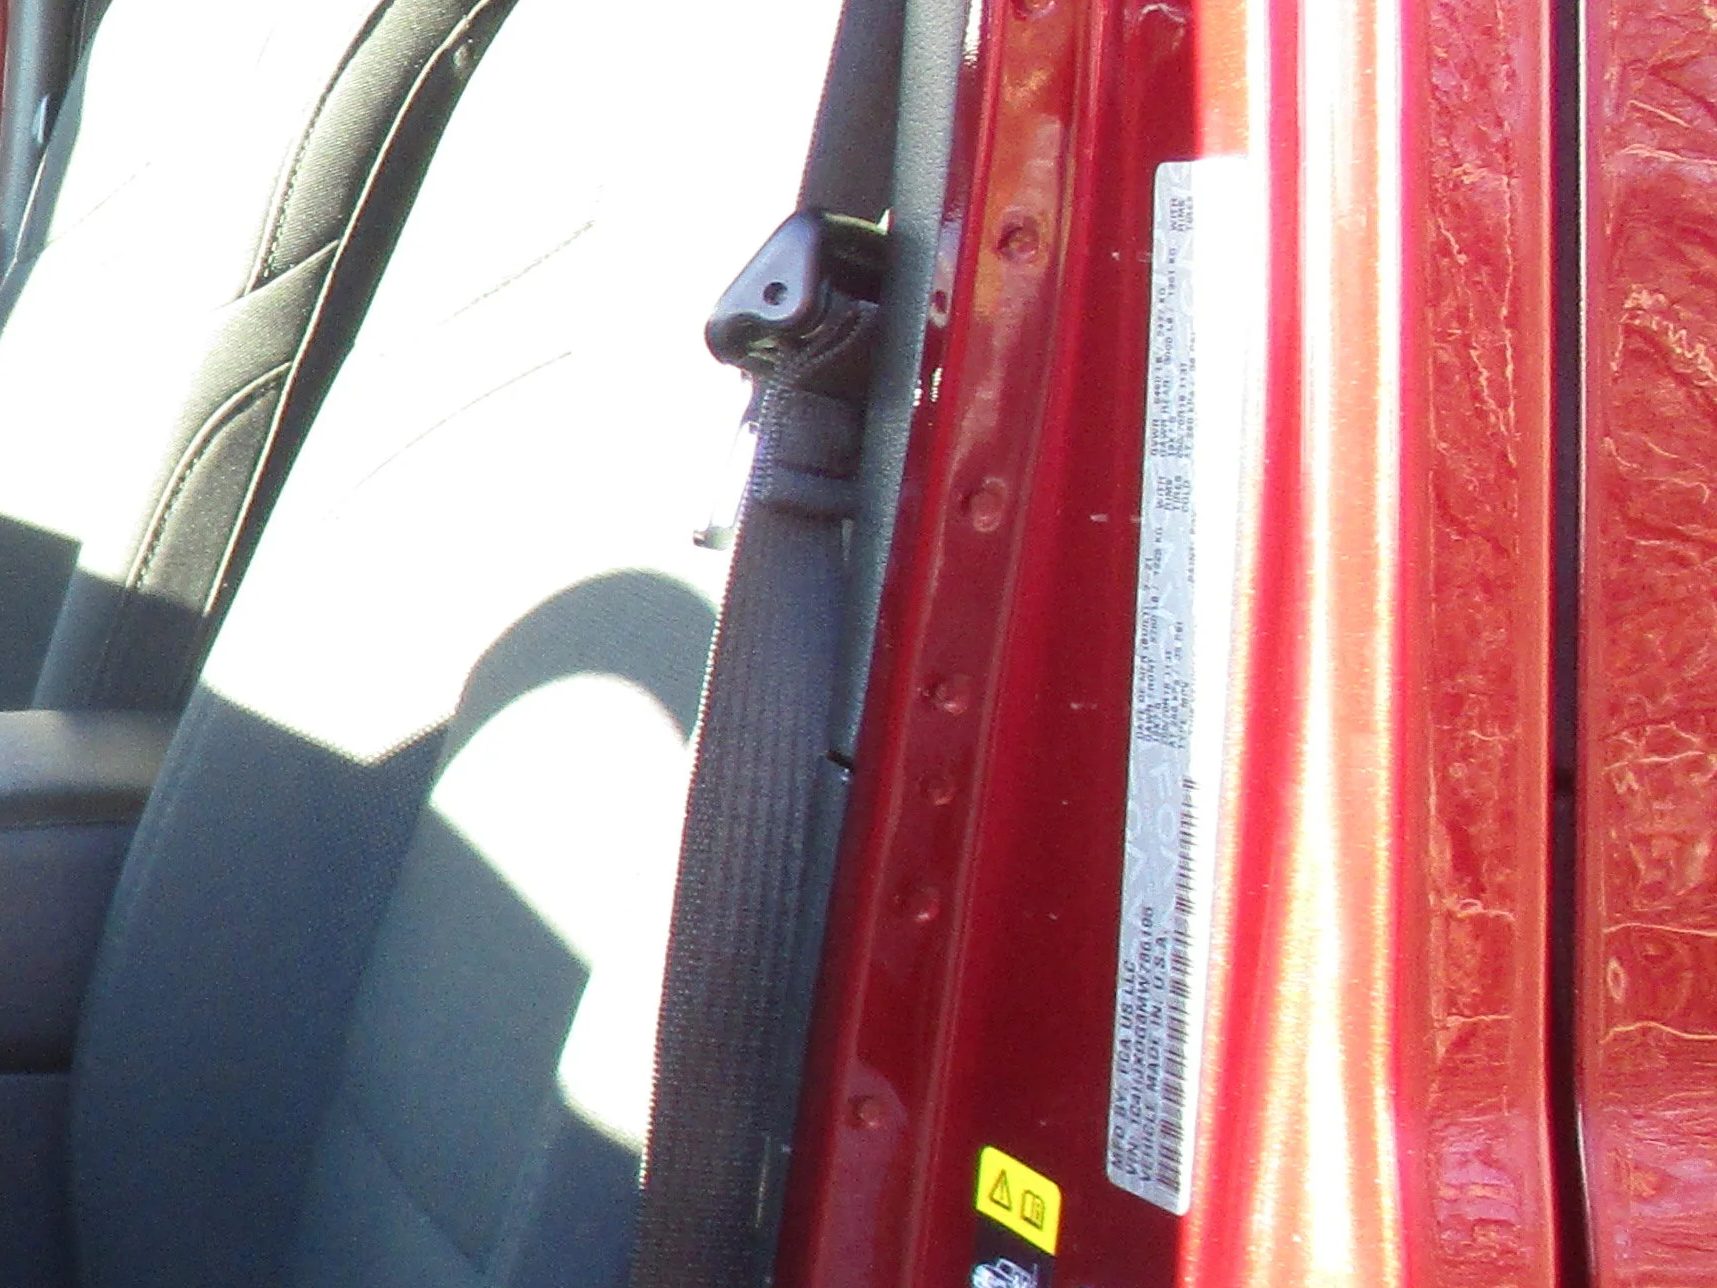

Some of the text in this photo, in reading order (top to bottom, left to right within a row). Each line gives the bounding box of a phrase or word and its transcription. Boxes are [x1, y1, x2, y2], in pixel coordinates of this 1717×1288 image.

[1121, 957, 1136, 998] LLC
[1145, 1031, 1161, 1095] MADE
[1138, 1097, 1156, 1185] VEHICLE
